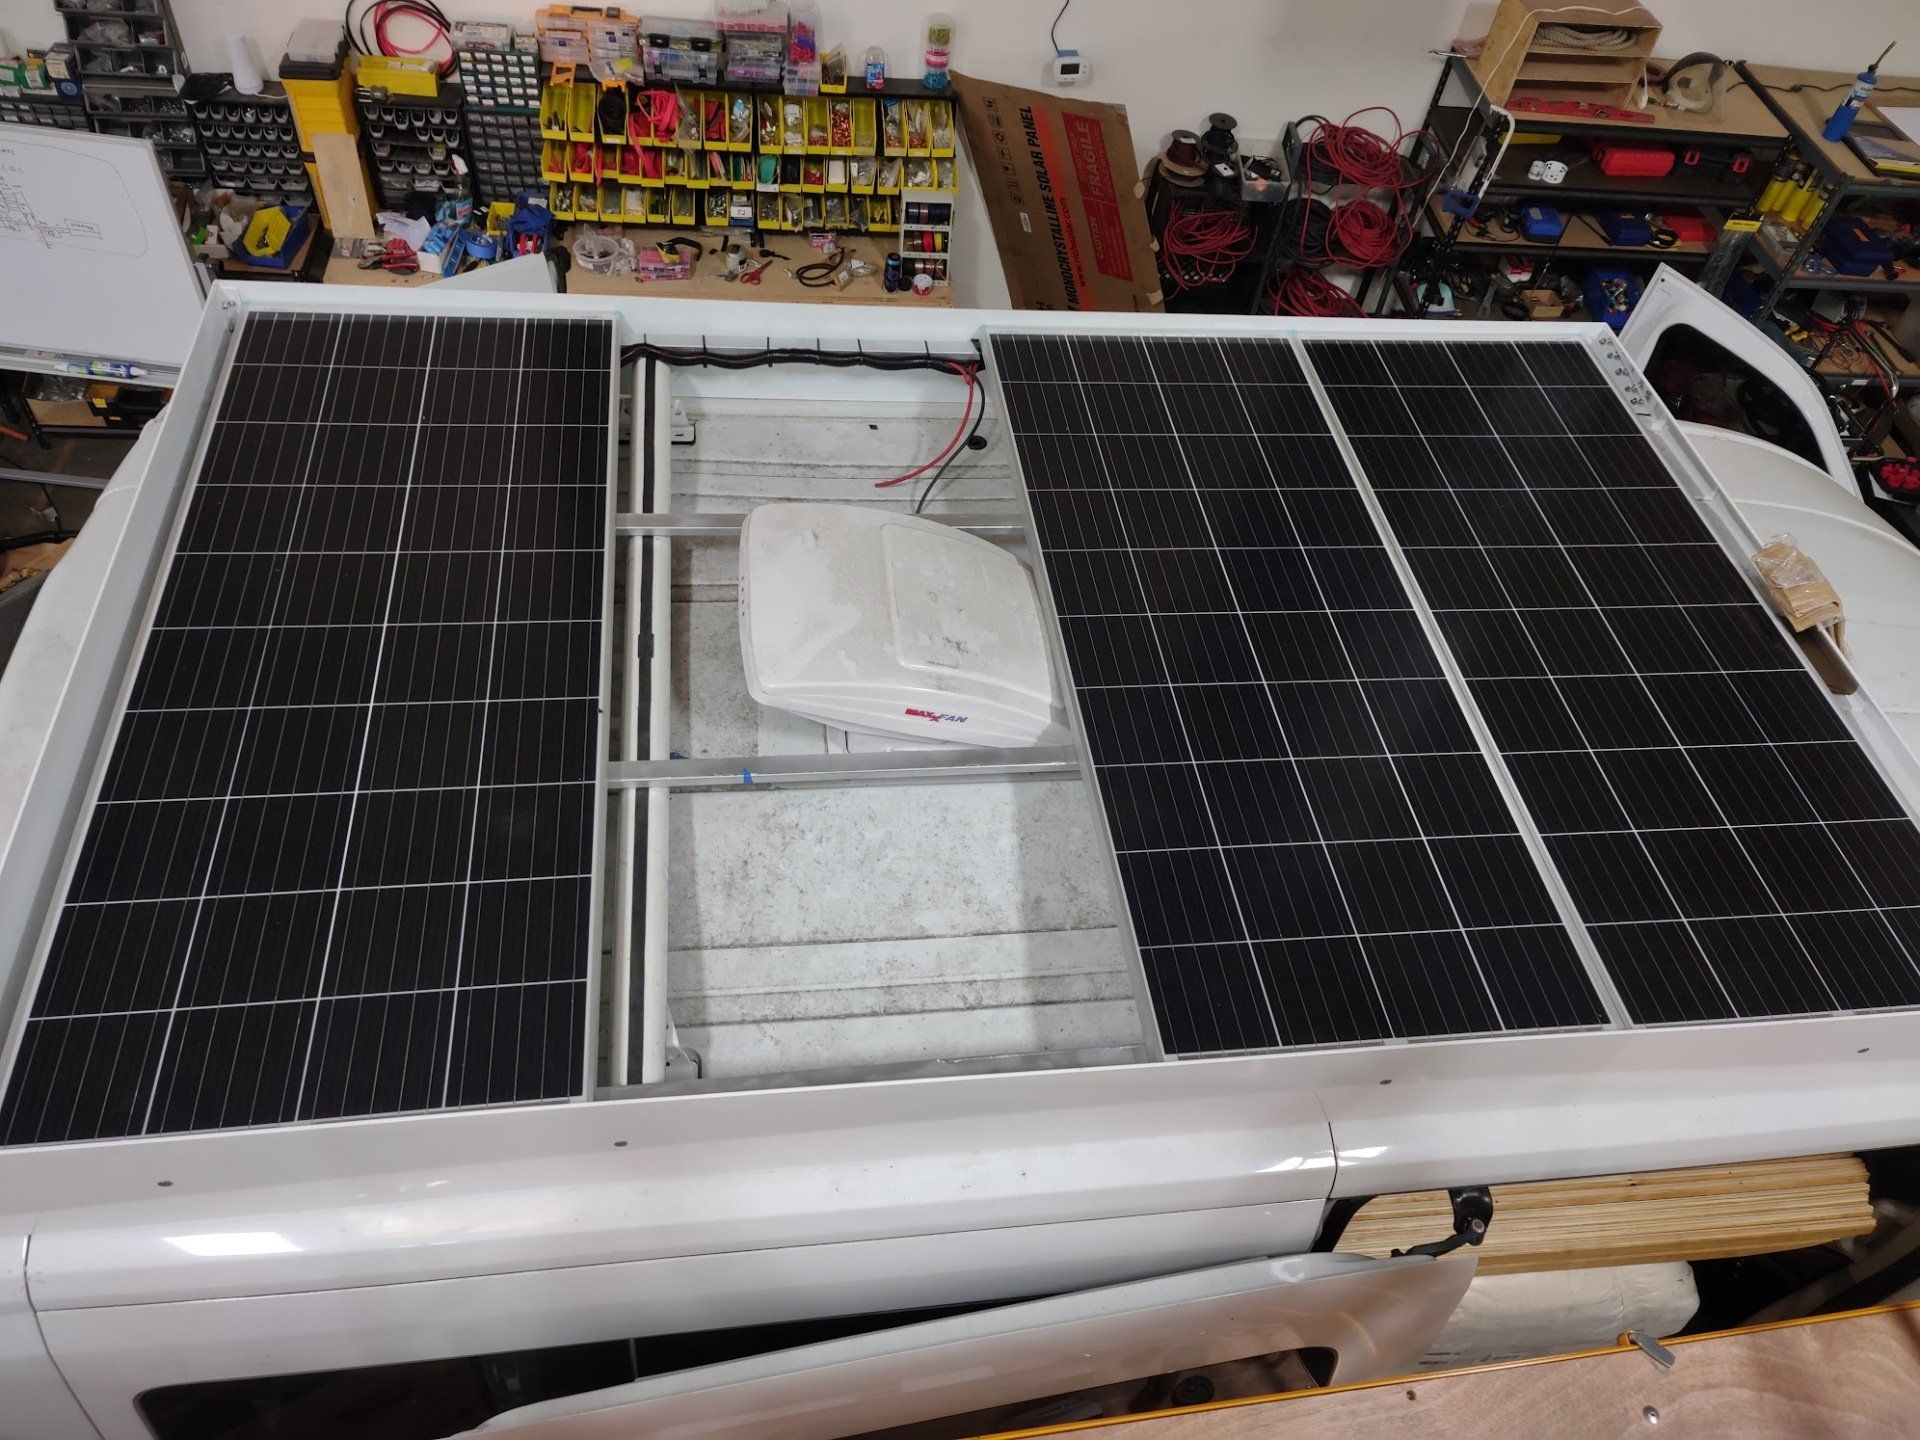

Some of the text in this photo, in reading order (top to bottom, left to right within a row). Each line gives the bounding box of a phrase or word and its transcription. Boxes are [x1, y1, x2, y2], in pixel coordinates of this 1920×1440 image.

[1019, 106, 1040, 148] PANEL
[1030, 150, 1052, 192] SOLAR
[1077, 121, 1103, 196] FRAGILE
[1042, 193, 1079, 304] MONOCRYSTALLINE
[1060, 198, 1086, 287] www.richsolar.com
[1090, 216, 1104, 259] CAUTION
